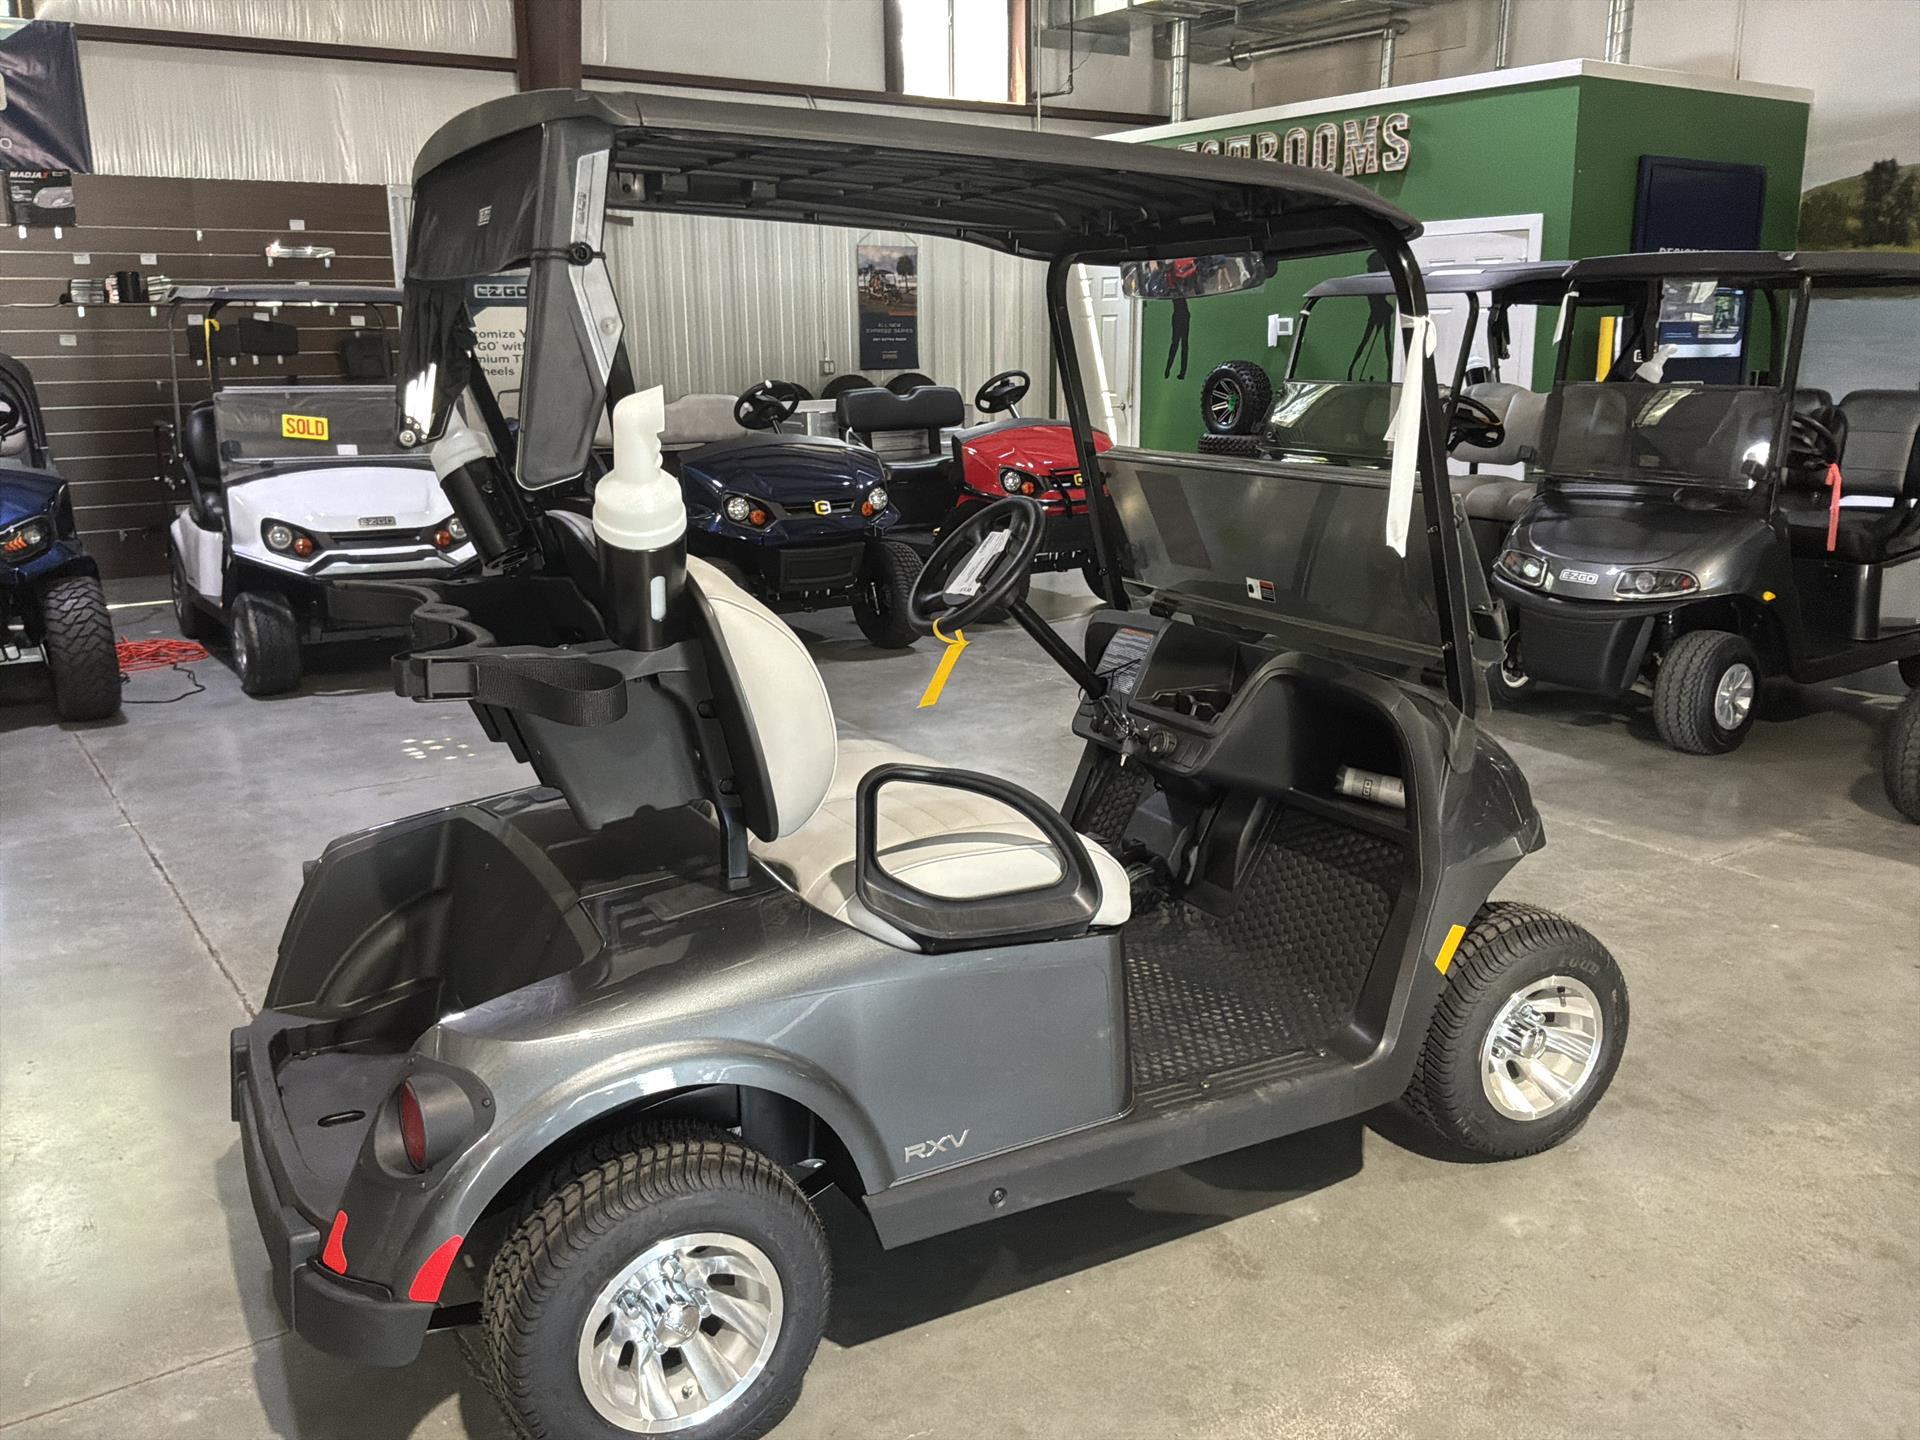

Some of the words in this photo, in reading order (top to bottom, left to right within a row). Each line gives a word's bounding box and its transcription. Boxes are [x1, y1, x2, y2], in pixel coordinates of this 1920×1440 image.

[1178, 112, 1412, 177] ROOMS
[475, 330, 515, 339] omize
[502, 341, 524, 351] wit
[478, 355, 510, 364] mium
[483, 366, 515, 376] heels
[286, 417, 325, 436] SOLD
[359, 517, 396, 525] EZGO
[1561, 571, 1597, 584] EZGO
[904, 1129, 970, 1163] RXV
